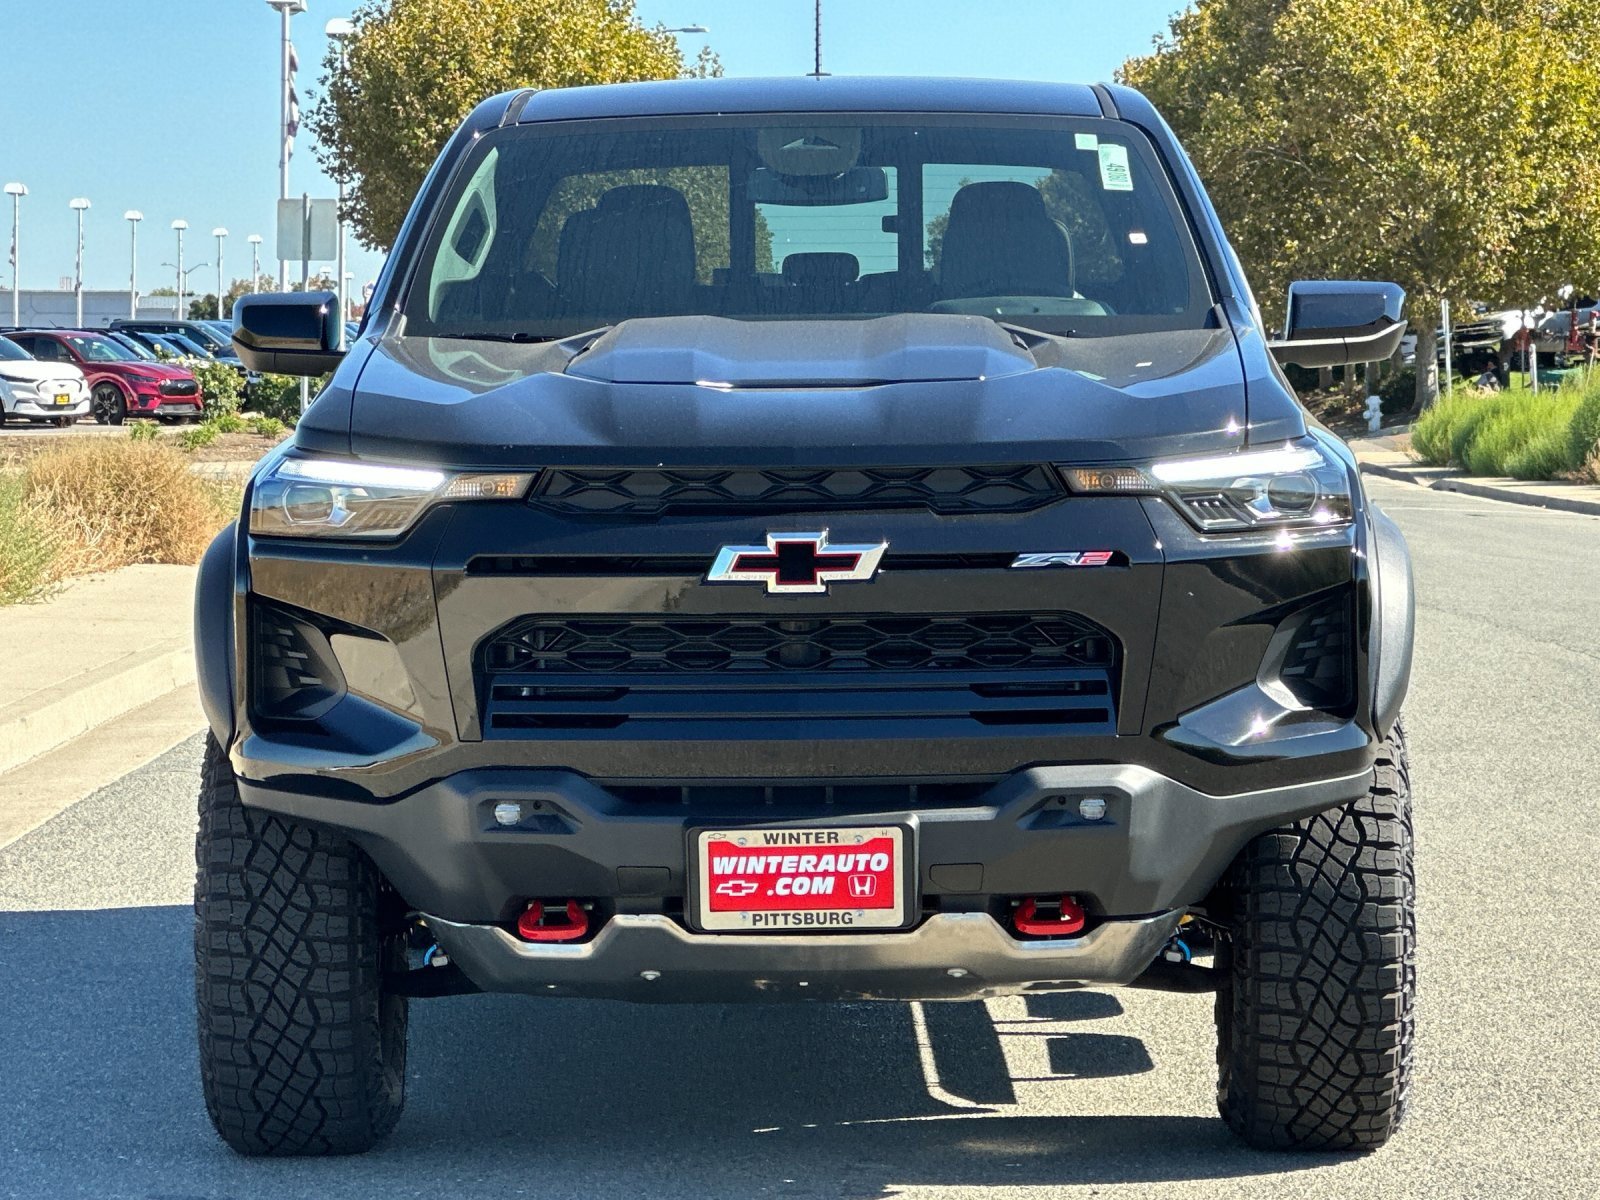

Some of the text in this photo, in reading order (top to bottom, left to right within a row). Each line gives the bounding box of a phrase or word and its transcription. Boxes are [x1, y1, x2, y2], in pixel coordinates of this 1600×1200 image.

[1011, 551, 1113, 568] ZR2
[763, 831, 839, 844] WINTER
[712, 852, 889, 875] WINTERAUTO
[767, 876, 835, 896] .COM
[752, 912, 853, 926] PITTSBURG
